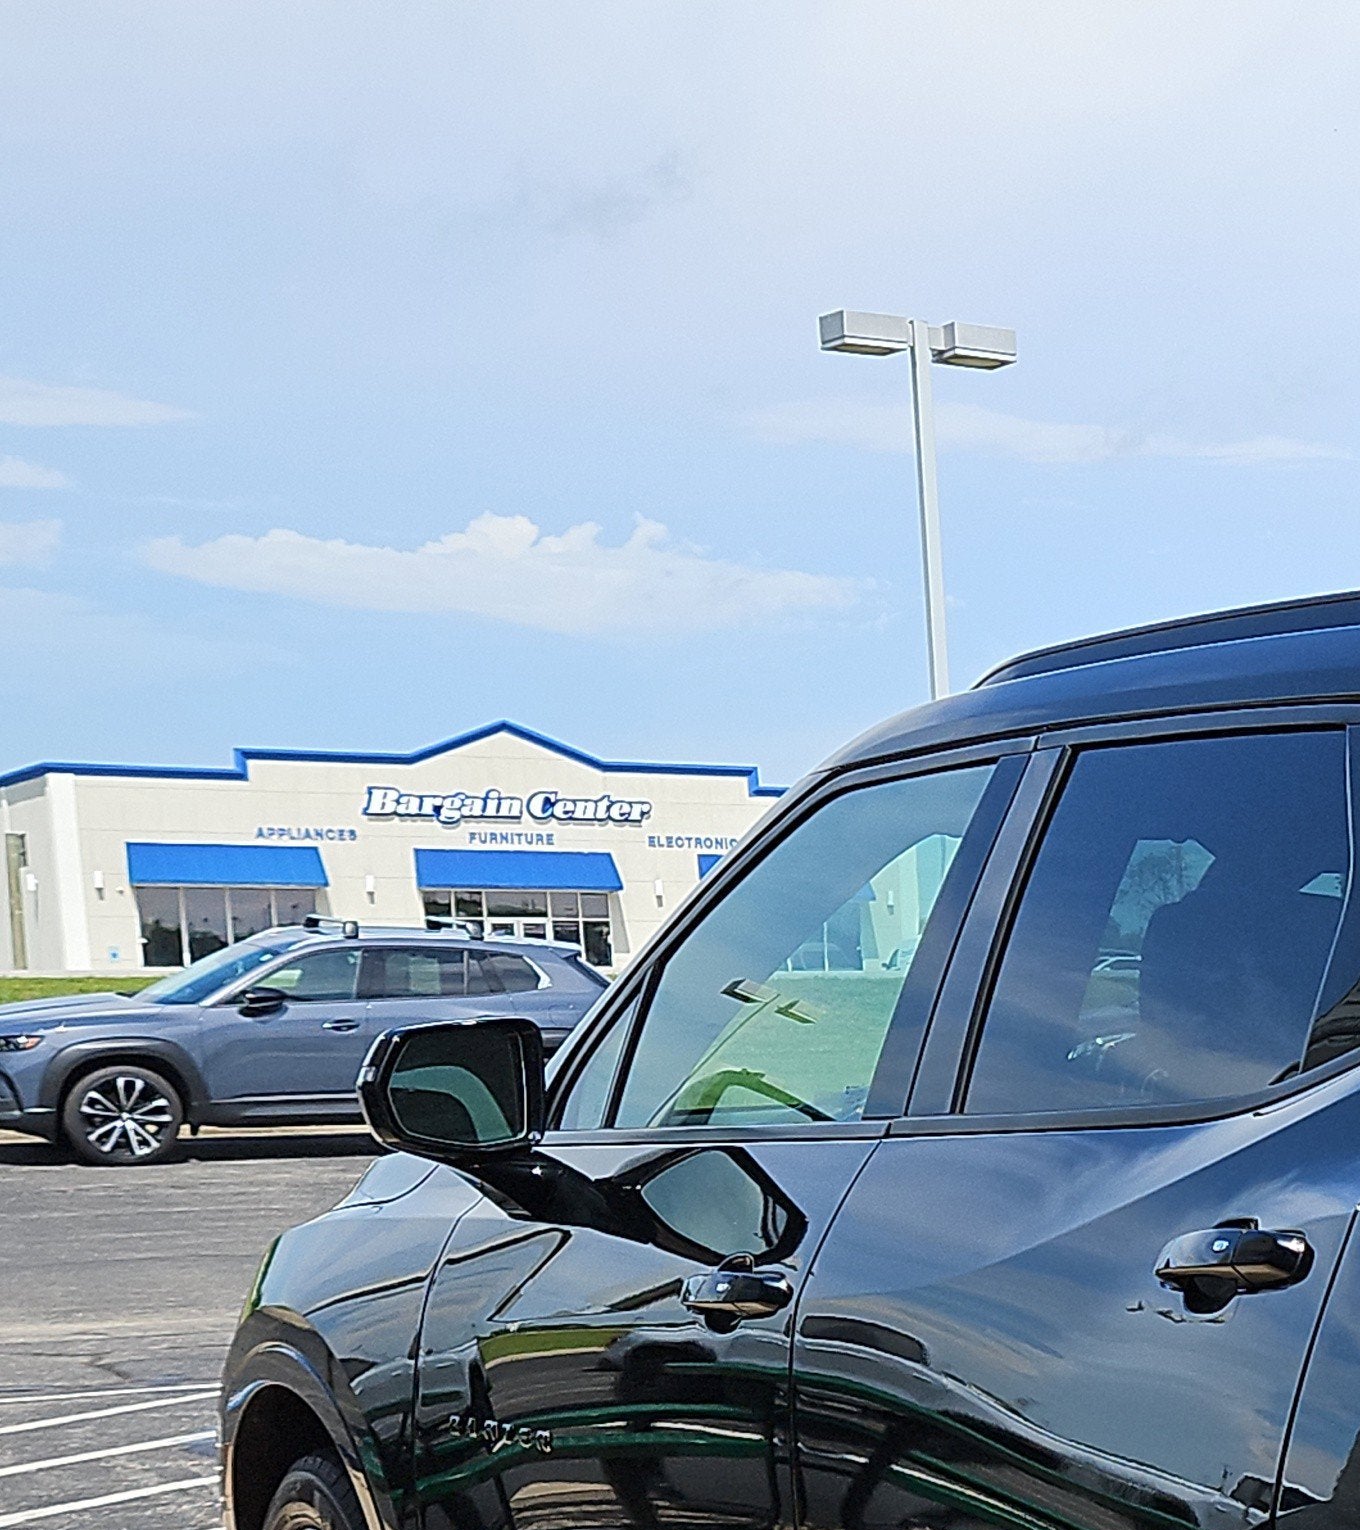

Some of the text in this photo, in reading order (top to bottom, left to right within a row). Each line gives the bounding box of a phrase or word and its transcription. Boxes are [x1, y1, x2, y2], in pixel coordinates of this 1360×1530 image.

[363, 786, 653, 824] Bargain Center
[255, 827, 358, 841] APPLIANCES
[468, 832, 555, 846] FURNITURE
